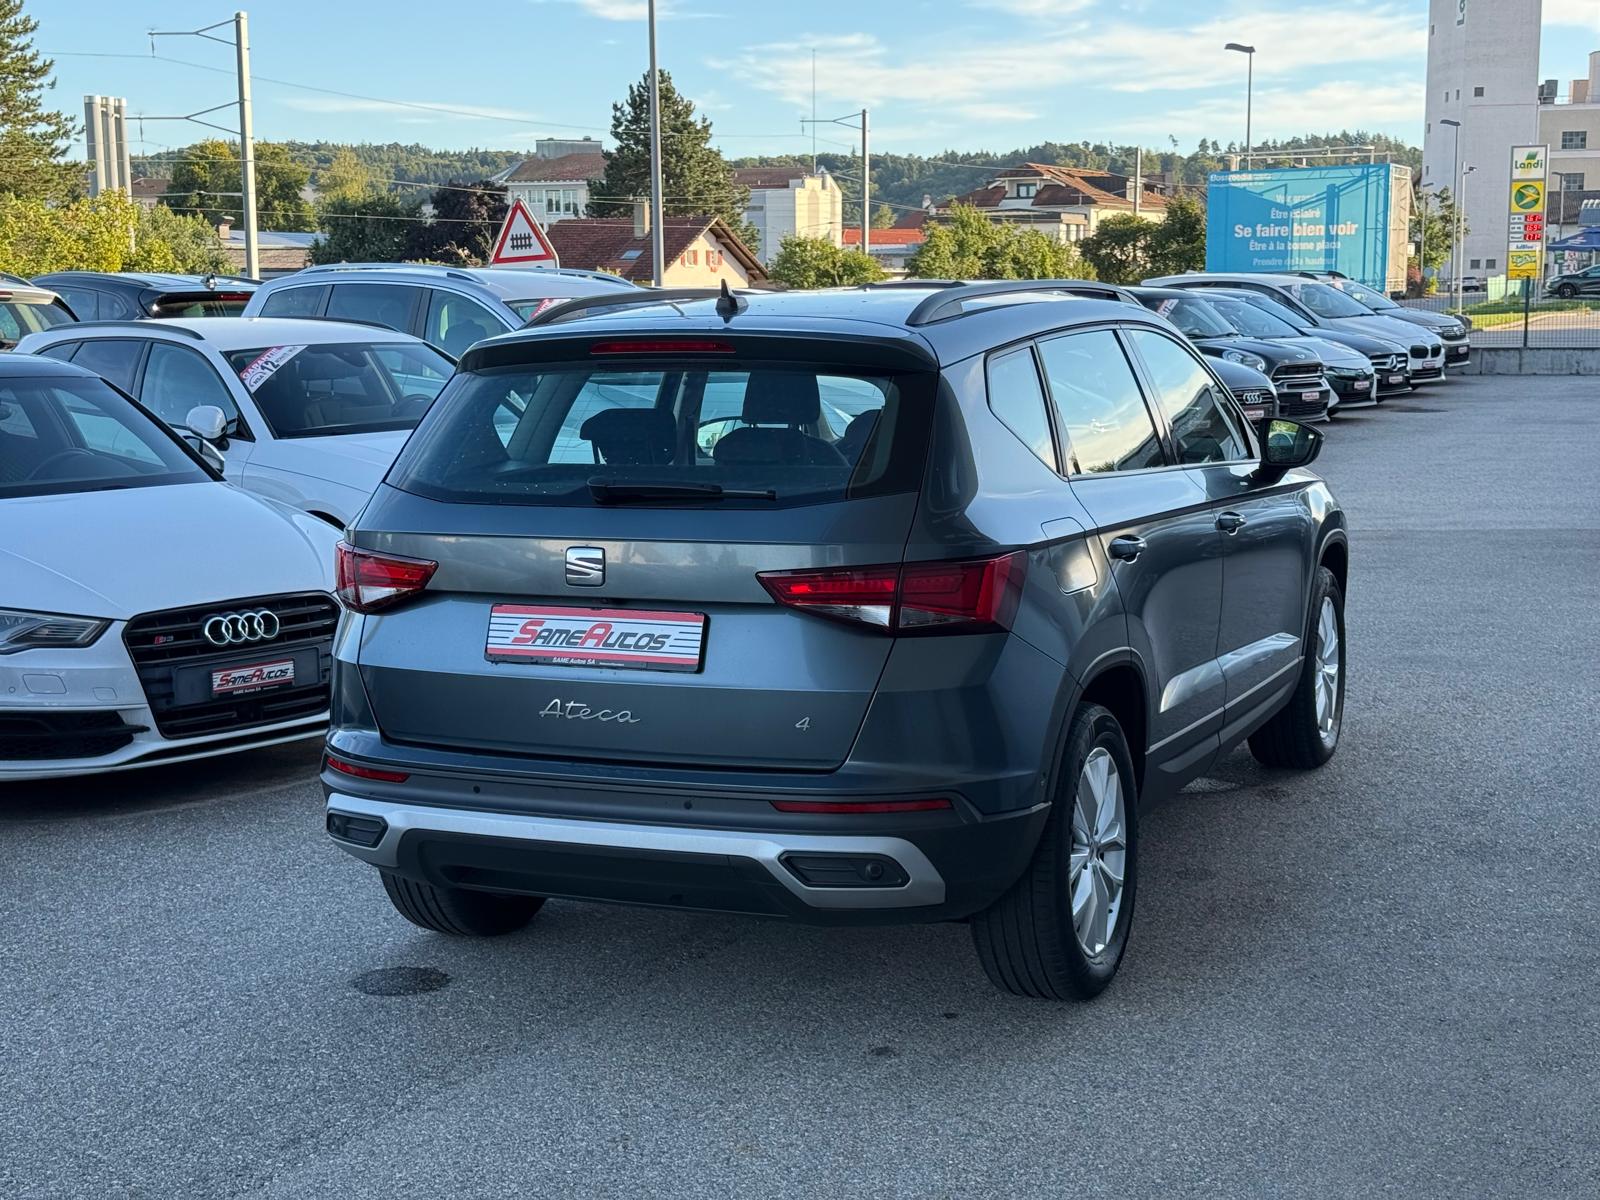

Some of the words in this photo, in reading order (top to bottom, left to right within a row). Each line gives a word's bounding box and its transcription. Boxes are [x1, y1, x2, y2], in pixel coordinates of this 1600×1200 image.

[1514, 159, 1543, 169] Landi
[1270, 208, 1288, 219] Être
[1234, 224, 1252, 237] Se
[1256, 223, 1289, 237] faire
[1292, 222, 1325, 237] bien
[1328, 221, 1358, 236] voir
[1249, 239, 1267, 251] Être
[1268, 240, 1274, 250] à
[1276, 240, 1285, 250] la
[260, 360, 280, 373] 12
[539, 698, 641, 723] Ateca
[795, 716, 811, 731] 4
